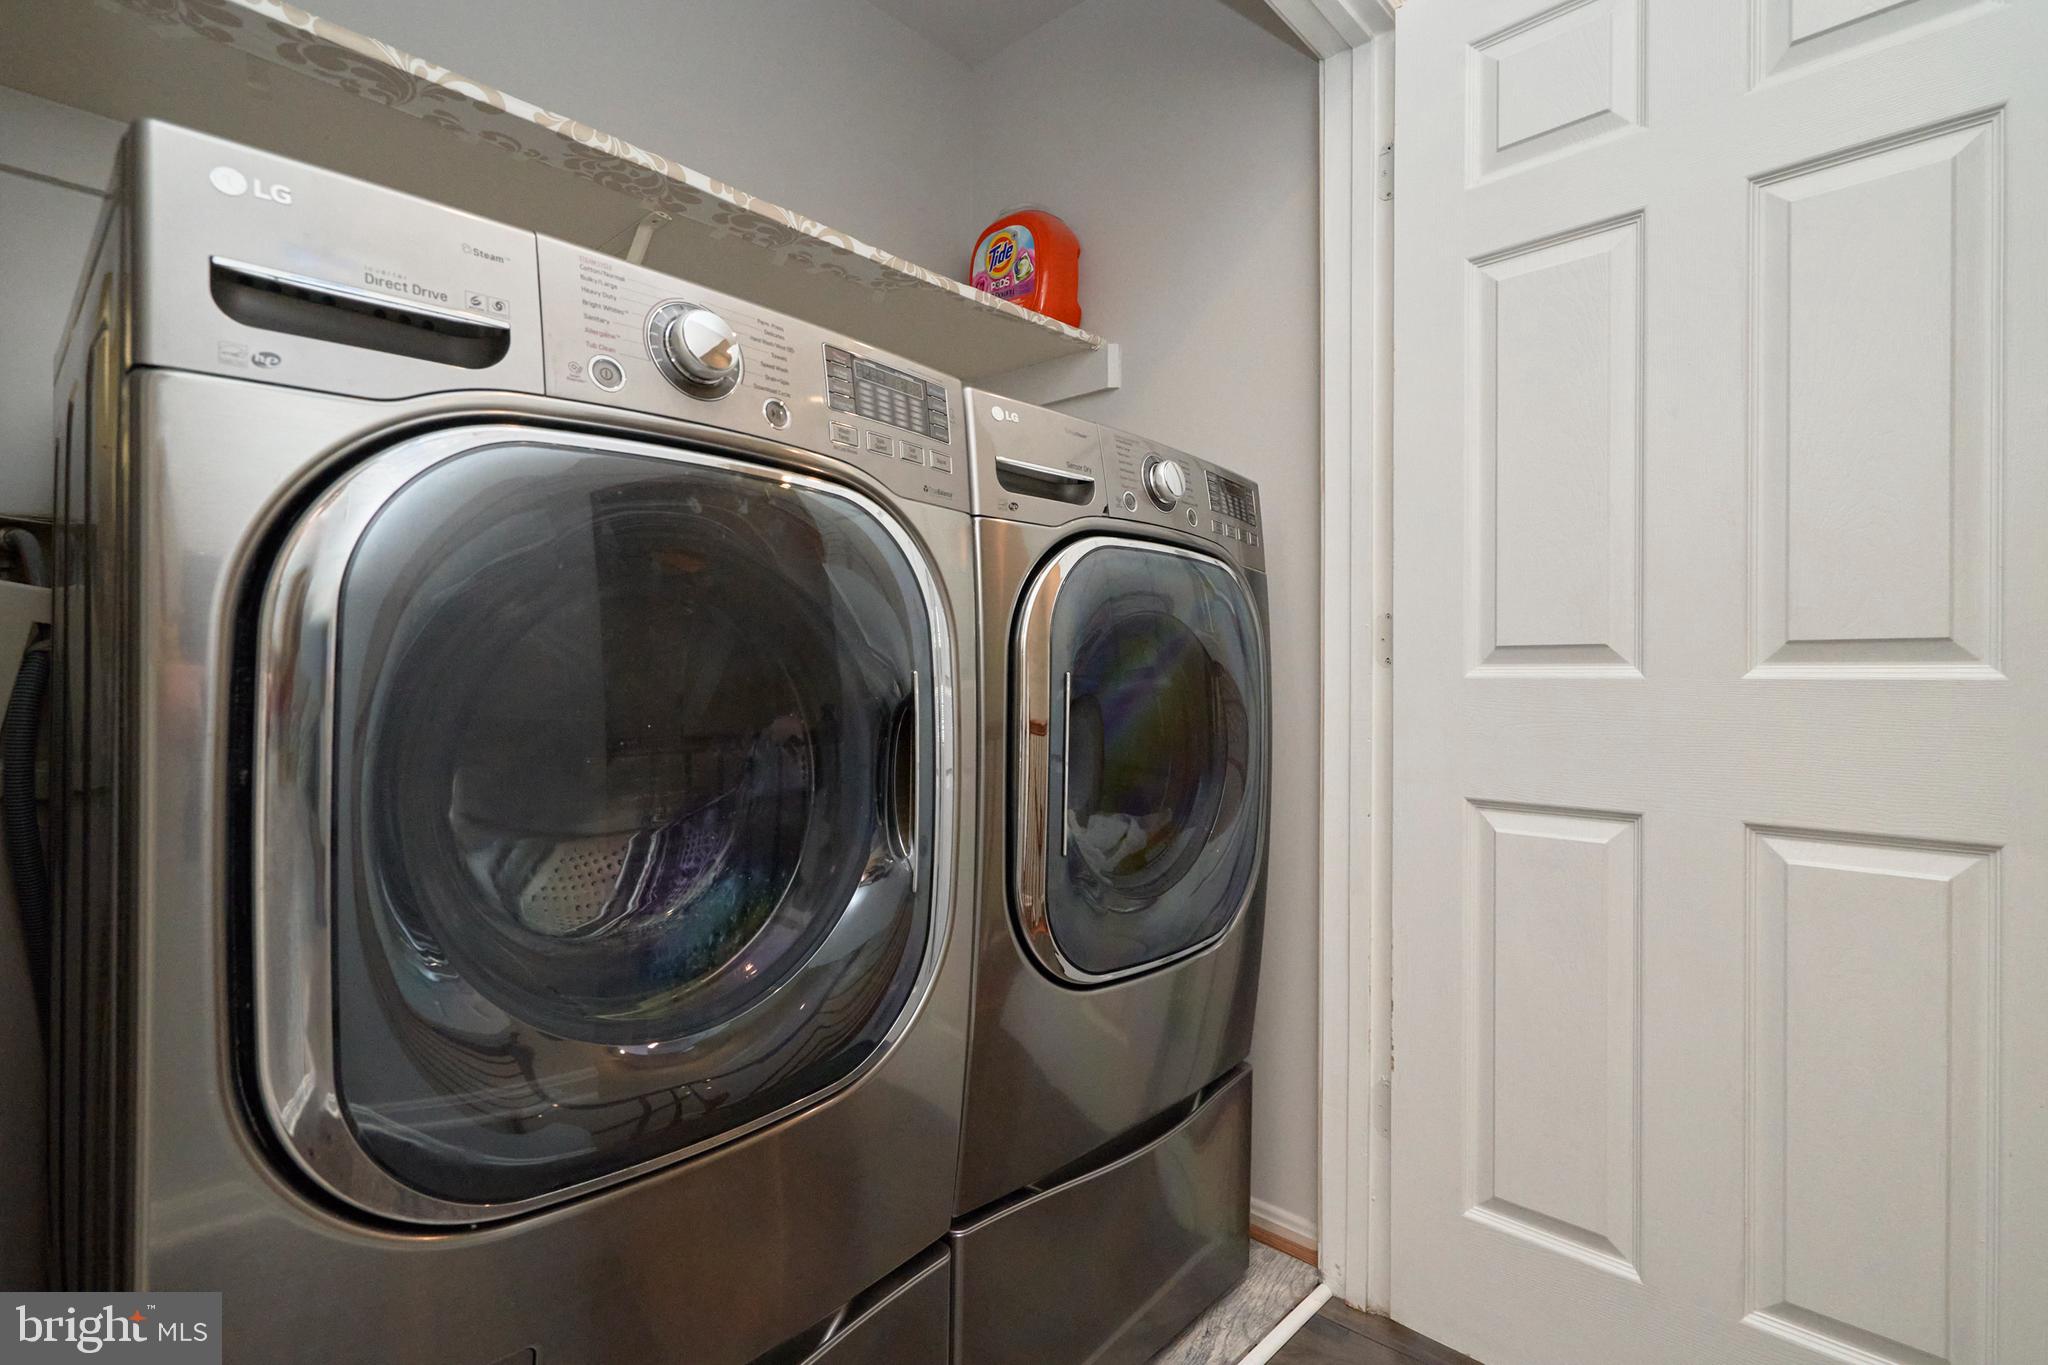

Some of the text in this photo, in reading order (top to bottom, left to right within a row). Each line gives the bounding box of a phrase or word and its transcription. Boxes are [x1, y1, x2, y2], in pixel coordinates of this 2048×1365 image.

[254, 177, 293, 205] LG
[472, 247, 505, 264] Steam
[989, 241, 1014, 273] Tide
[364, 272, 448, 302] Direct Drive
[1005, 410, 1020, 423] LG
